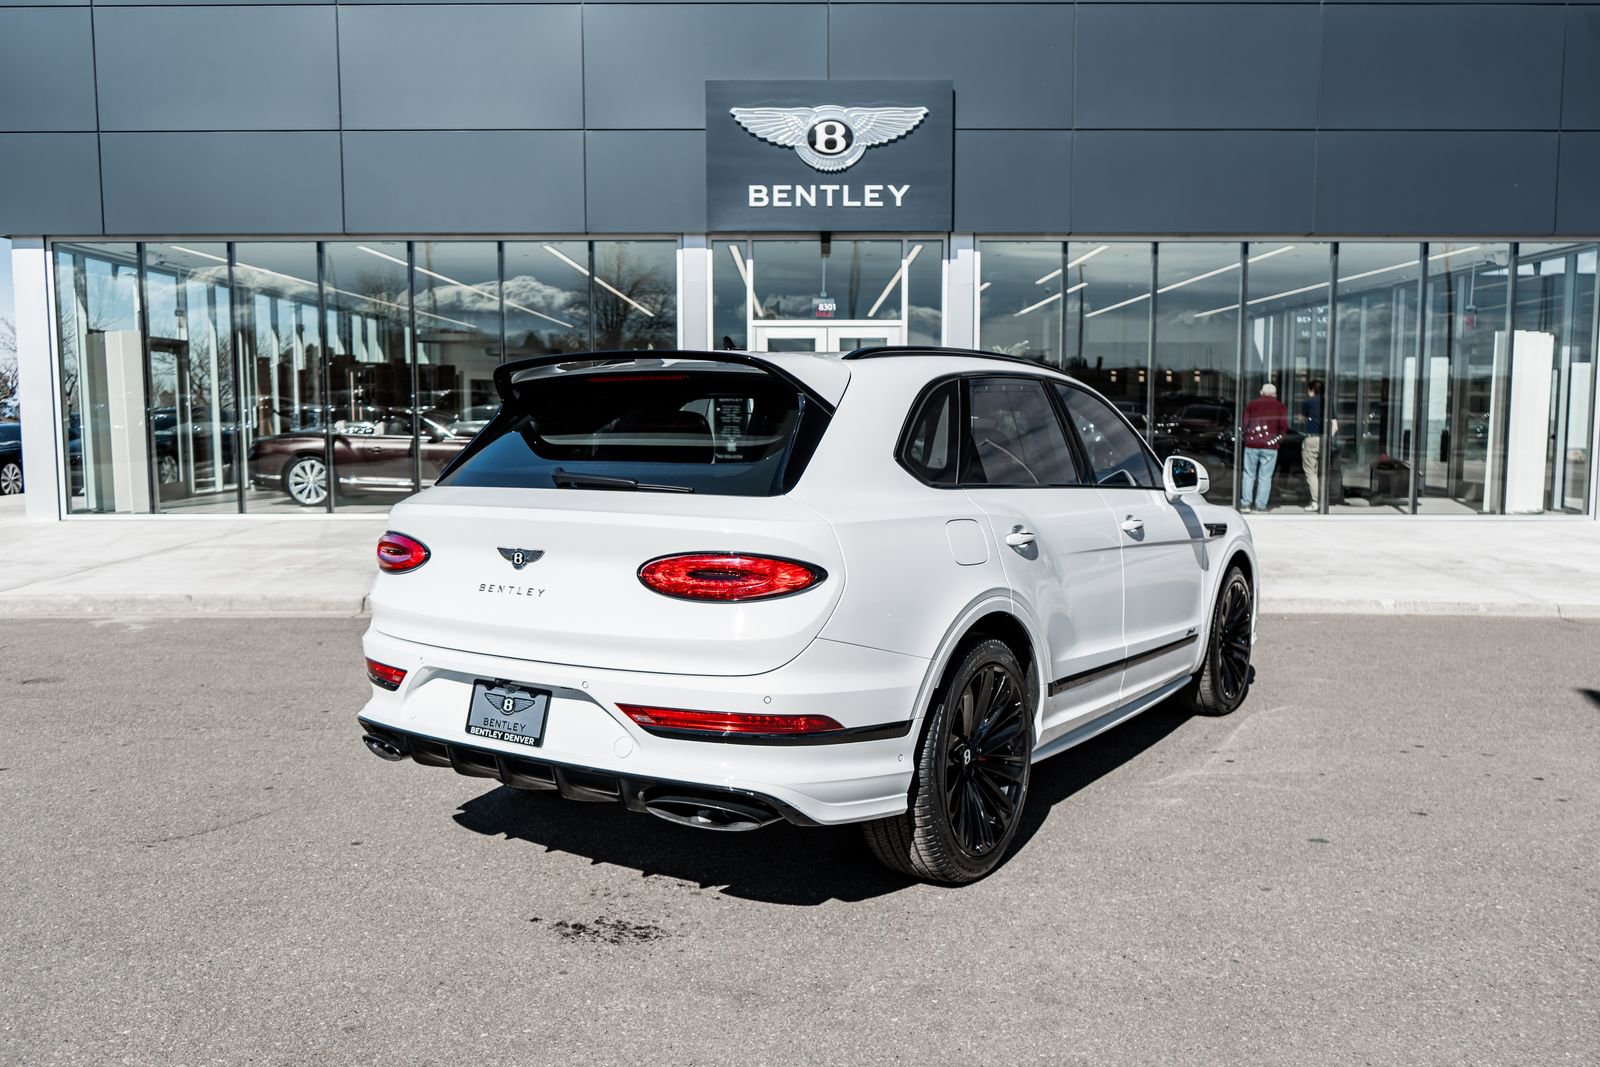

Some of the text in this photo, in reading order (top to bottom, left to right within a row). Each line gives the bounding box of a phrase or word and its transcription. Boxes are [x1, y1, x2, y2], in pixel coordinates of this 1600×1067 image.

[815, 121, 847, 154] B
[748, 184, 911, 207] BENTLEY
[818, 303, 836, 311] 8301
[513, 552, 523, 564] B
[479, 583, 546, 597] BENTLEY
[483, 717, 527, 732] BENTLEY
[470, 726, 535, 746] BENTLEY DENVER
